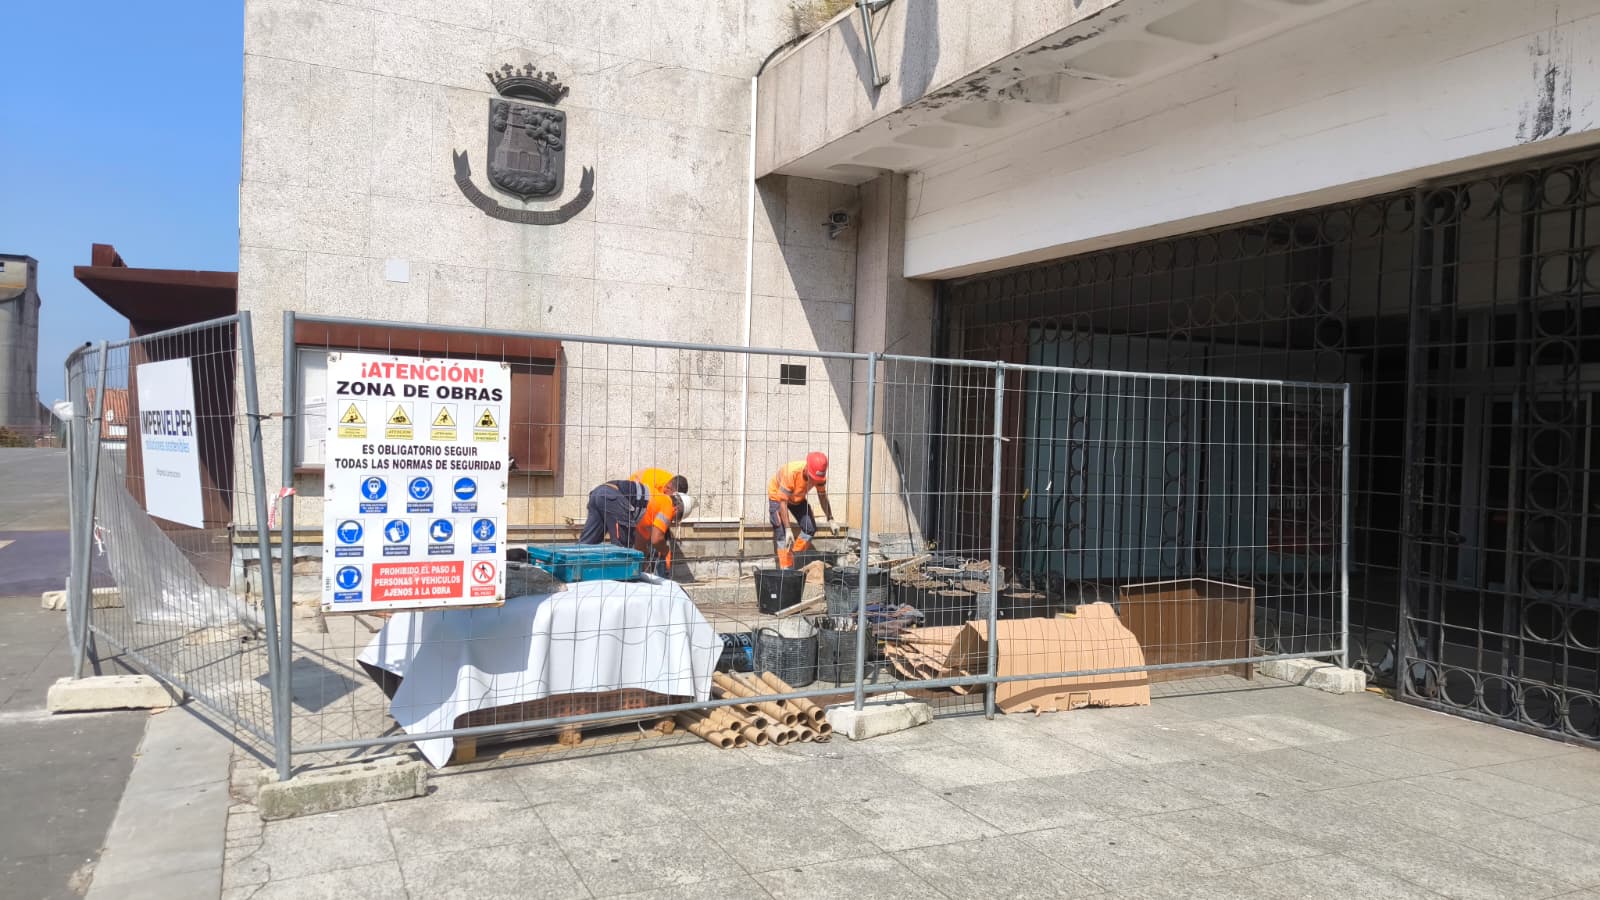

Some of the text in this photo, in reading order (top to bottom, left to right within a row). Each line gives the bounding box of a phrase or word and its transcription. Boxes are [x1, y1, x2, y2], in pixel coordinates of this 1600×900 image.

[361, 362, 484, 383] ¡ATENCIÓN!
[337, 381, 503, 401] ZONA DE OBRAS
[141, 409, 193, 437] IMPERVELPER
[362, 444, 477, 456] ES OBLIGATORIO SEGUIR
[335, 458, 501, 470] TODAS LAS NORMAS DE SEGURIDAD
[380, 567, 420, 576] PROHIBIDO
[421, 566, 431, 574] EL
[432, 566, 450, 574] PASO
[374, 577, 413, 586] PERSONAS
[415, 576, 420, 585] Y
[384, 585, 451, 596] AJENOS A LA OBRA
